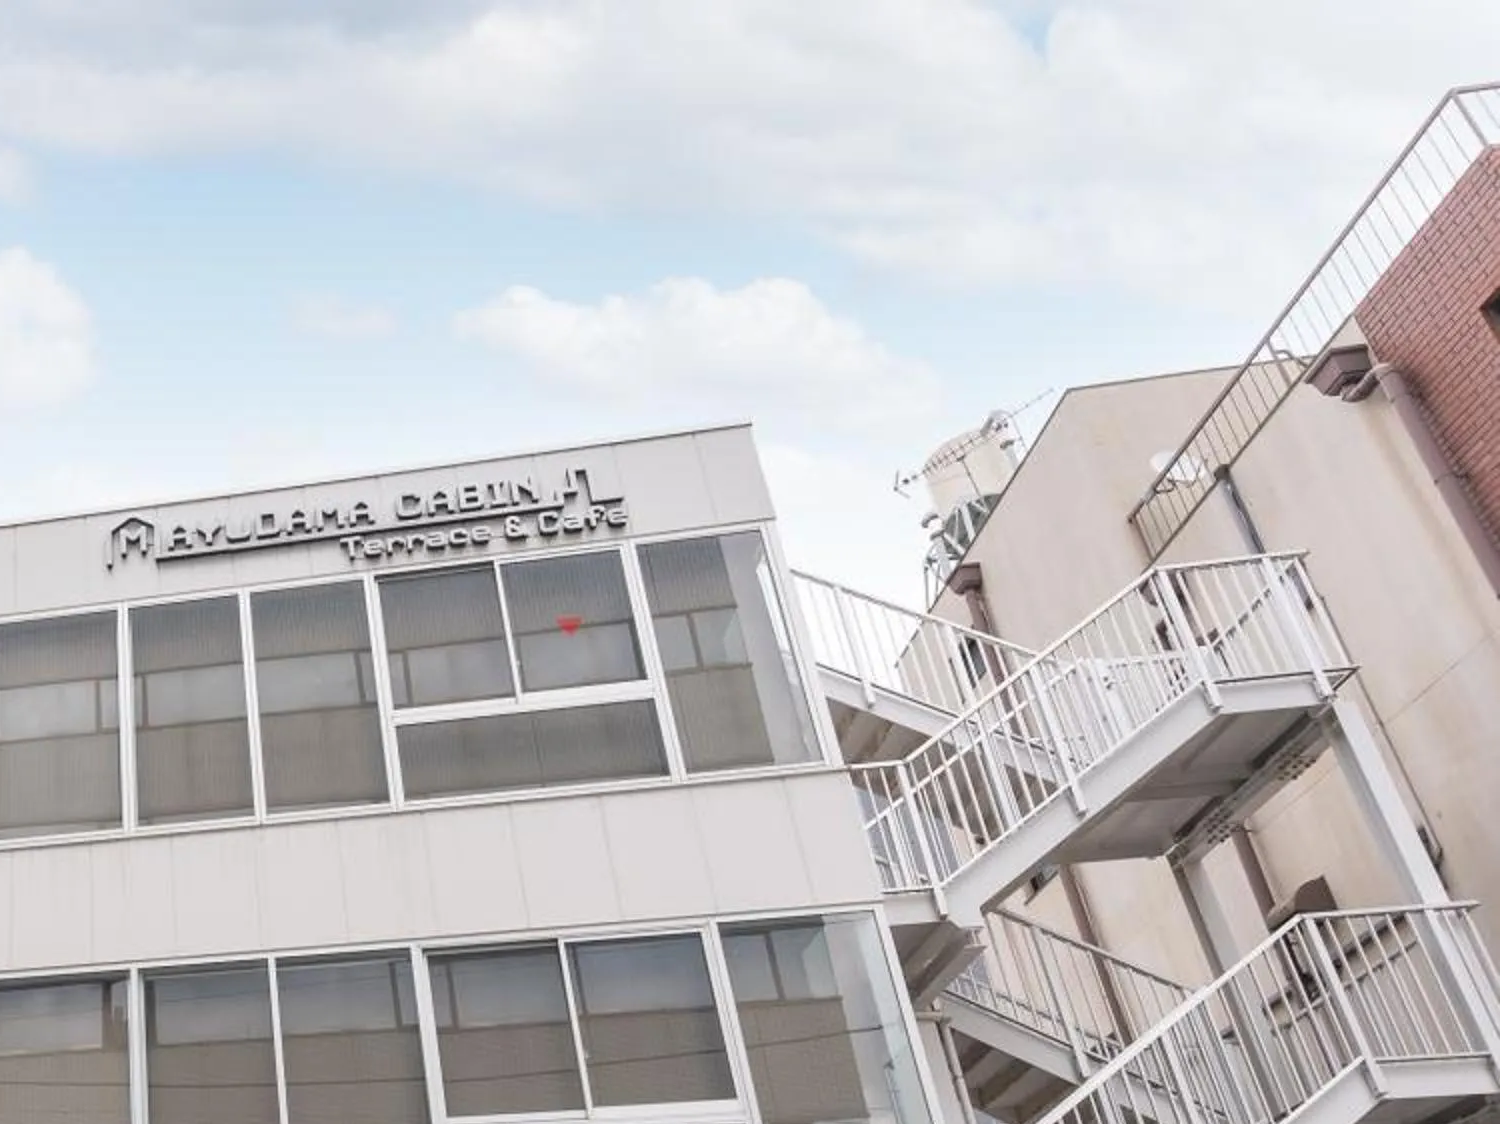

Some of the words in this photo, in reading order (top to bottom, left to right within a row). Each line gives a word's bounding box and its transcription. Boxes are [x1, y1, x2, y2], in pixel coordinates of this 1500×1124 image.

[394, 475, 540, 521] CABIN
[339, 522, 493, 561] Terrace
[503, 514, 523, 540] &
[537, 502, 630, 536] Cafe
